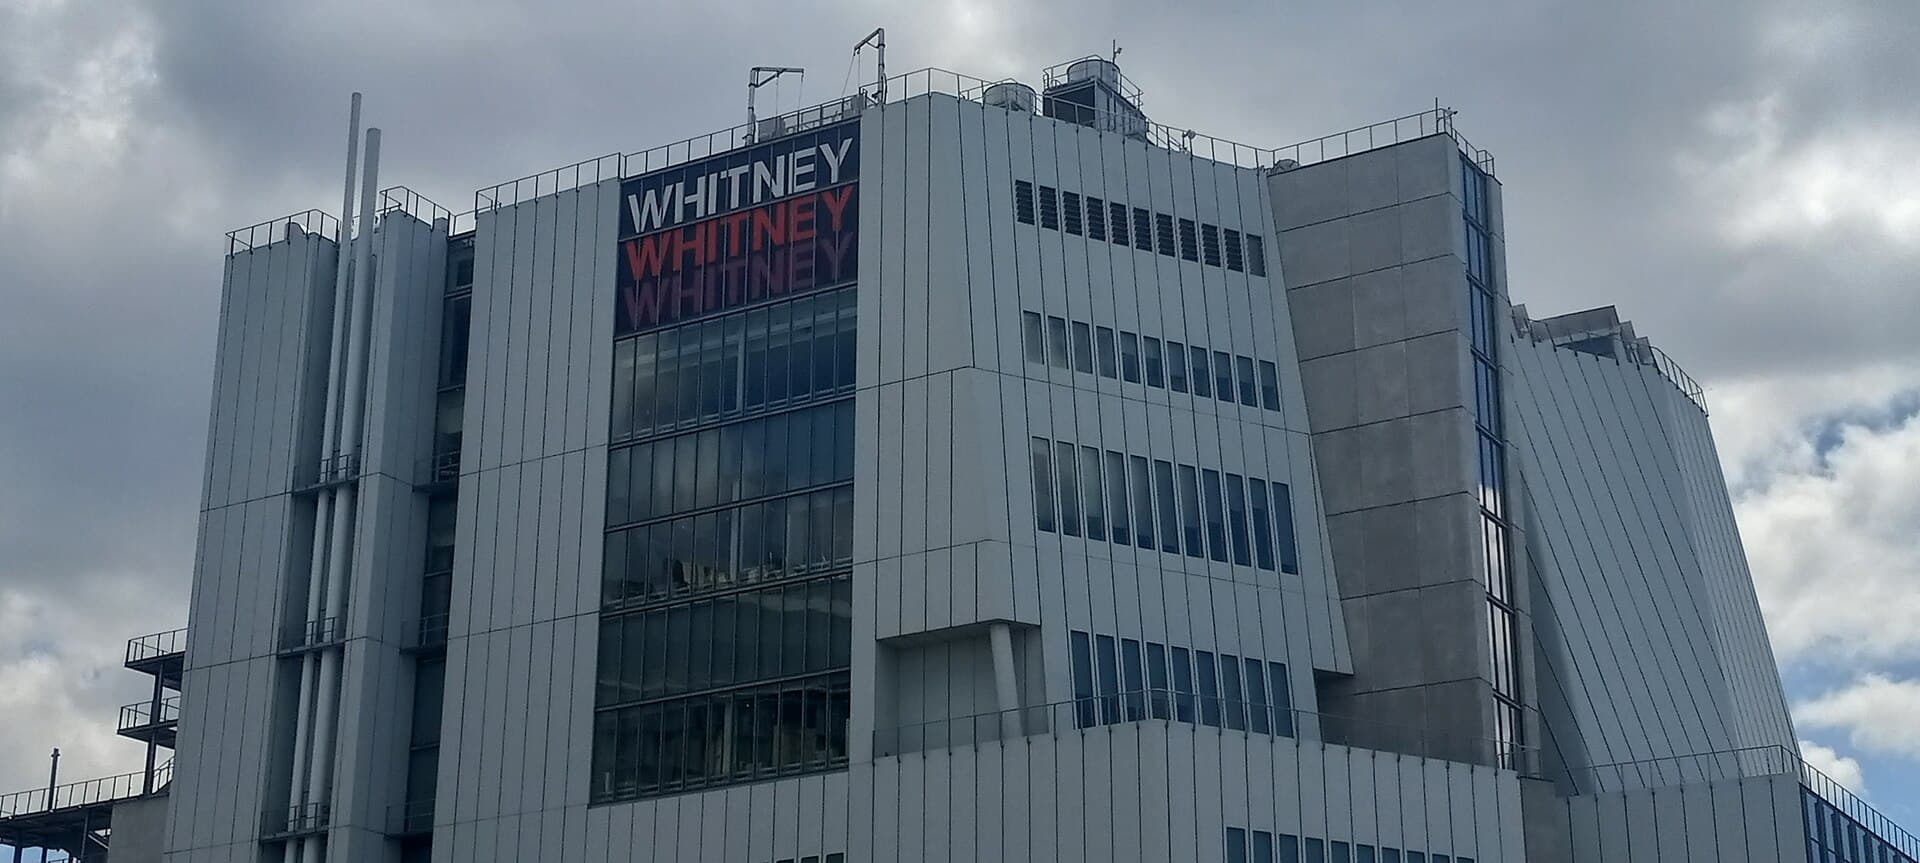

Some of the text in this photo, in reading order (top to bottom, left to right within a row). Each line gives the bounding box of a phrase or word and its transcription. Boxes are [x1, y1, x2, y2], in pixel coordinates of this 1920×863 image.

[626, 185, 854, 281] WHITNEY
[628, 138, 853, 234] WHITNEY
[624, 231, 854, 330] WHITNEY
